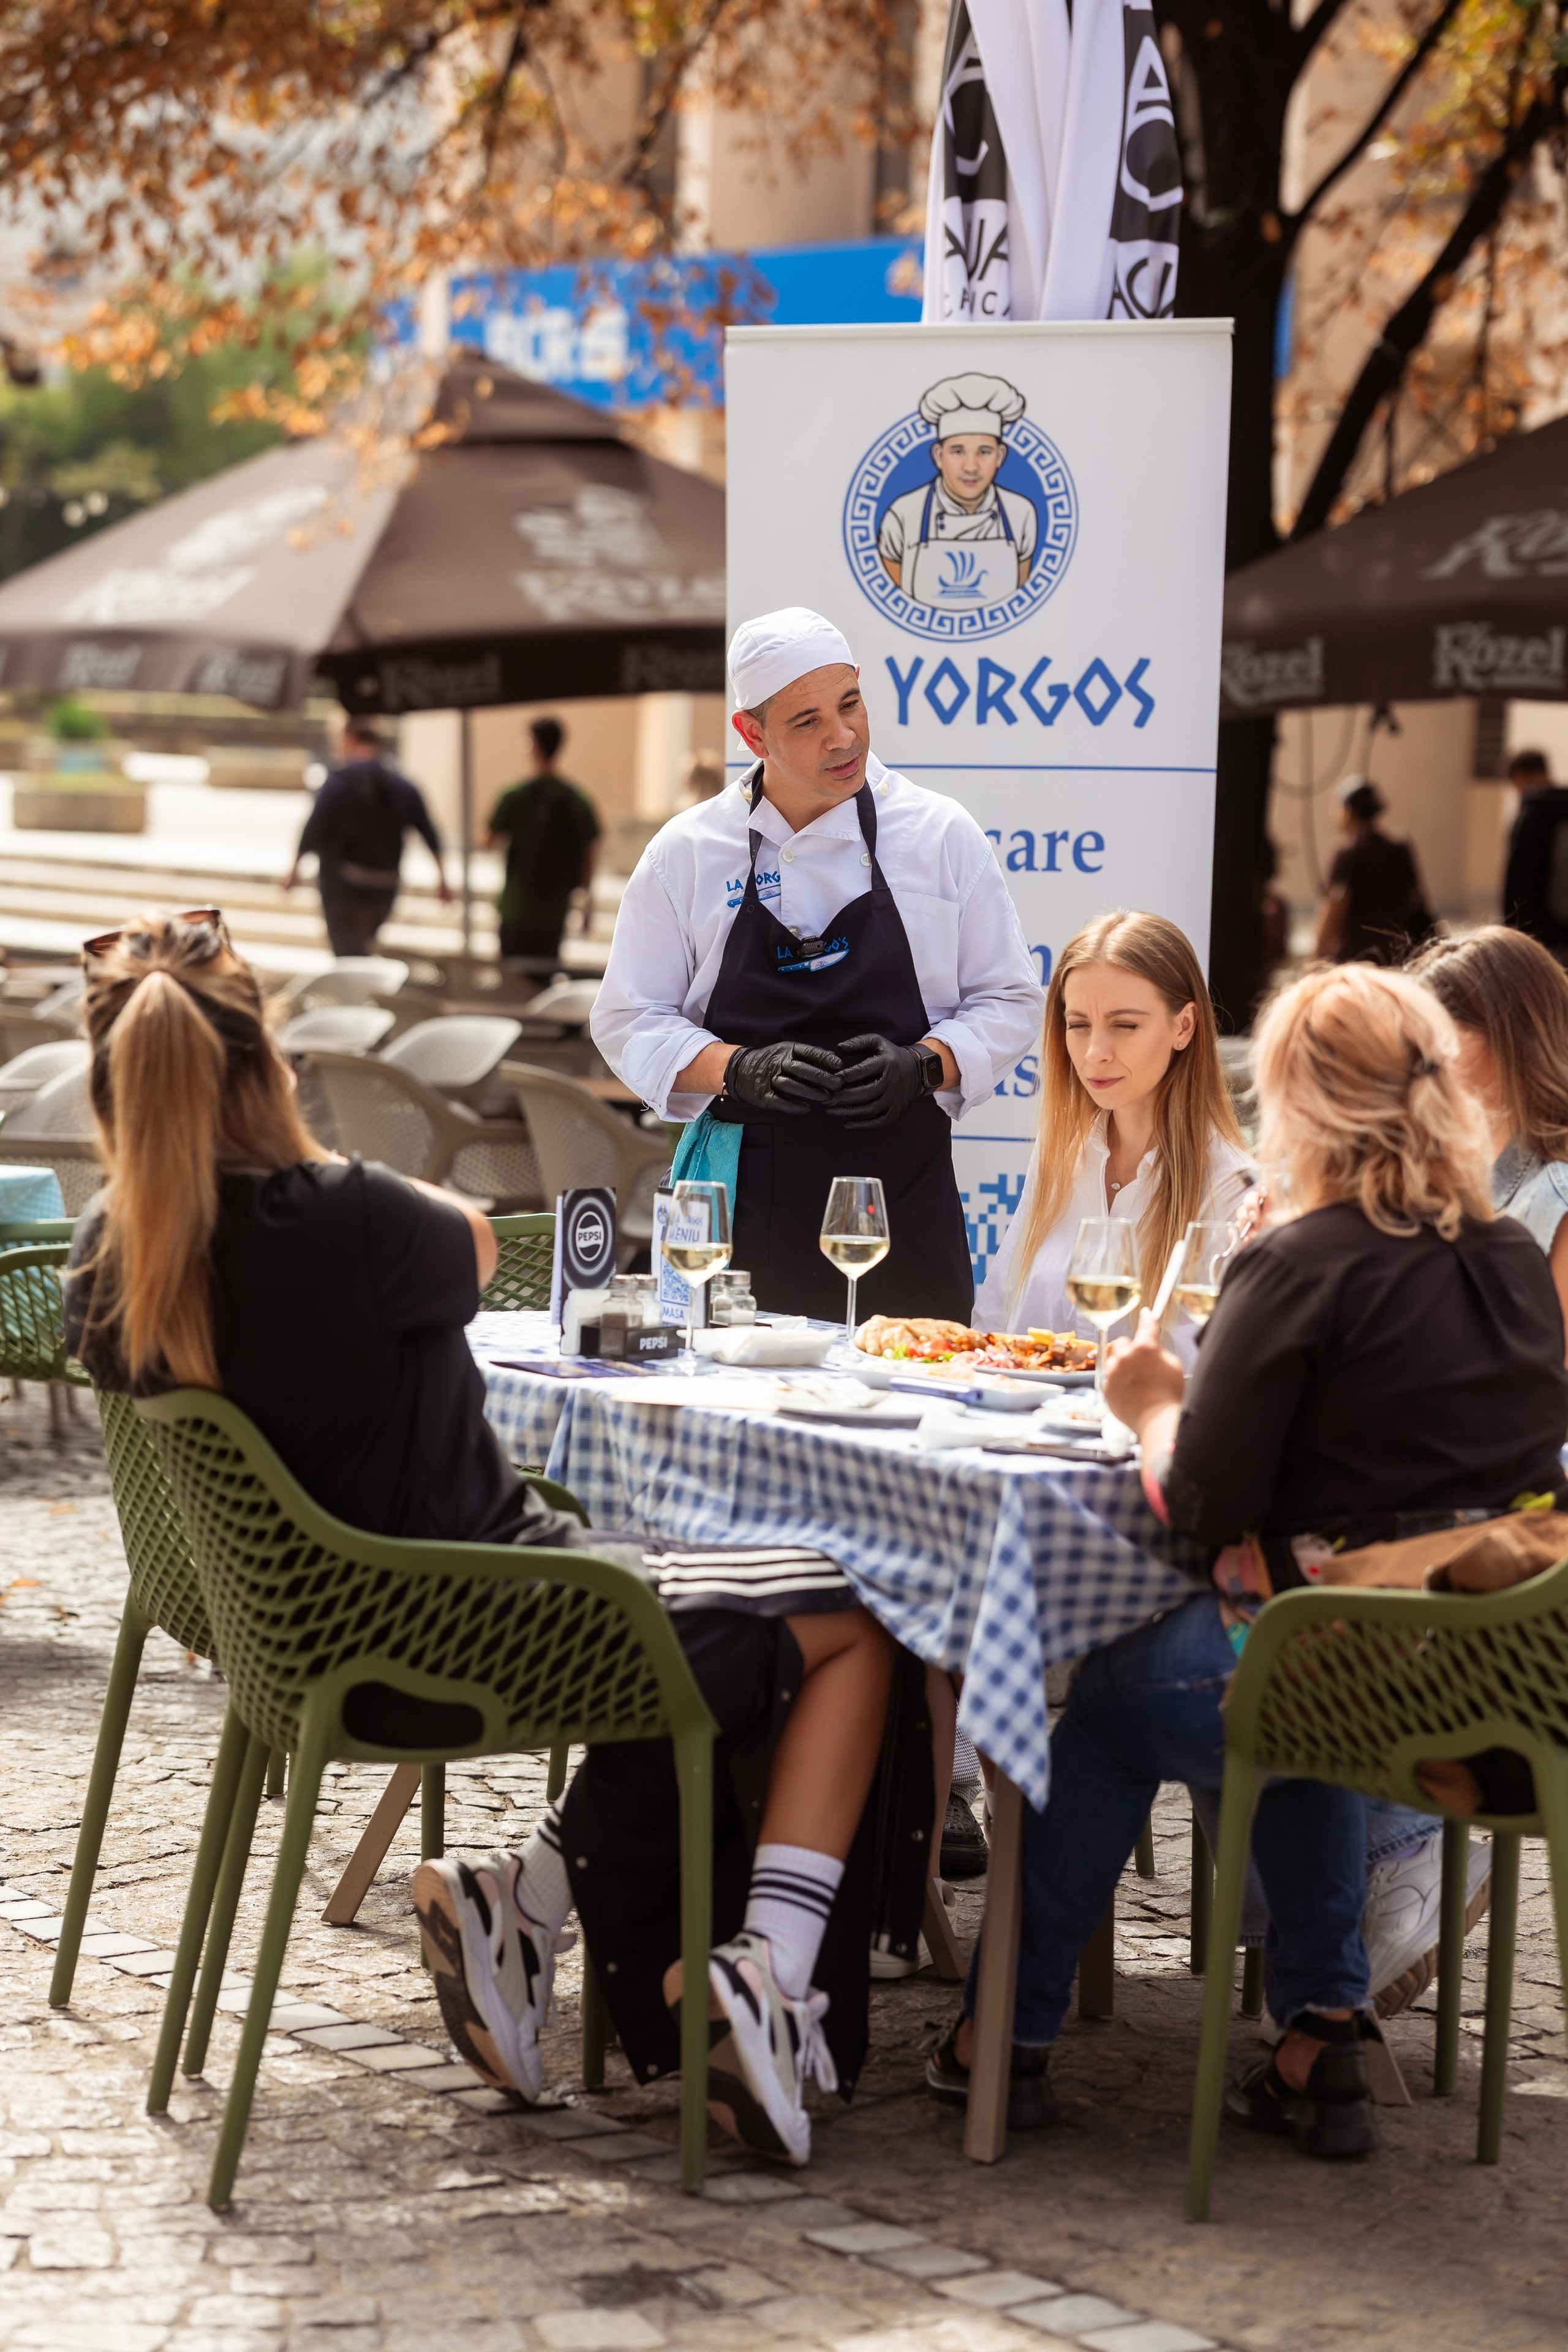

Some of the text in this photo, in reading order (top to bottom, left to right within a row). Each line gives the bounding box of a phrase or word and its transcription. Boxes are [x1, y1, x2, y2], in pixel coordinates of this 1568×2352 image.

[1433, 621, 1566, 689] Kozel
[885, 655, 1155, 728] YORGOS
[726, 870, 781, 892] LA ORG
[777, 946, 793, 959] LA
[578, 1231, 601, 1241] PEPSI
[663, 1307, 684, 1320] MASA
[639, 1336, 668, 1351] PEPSI
